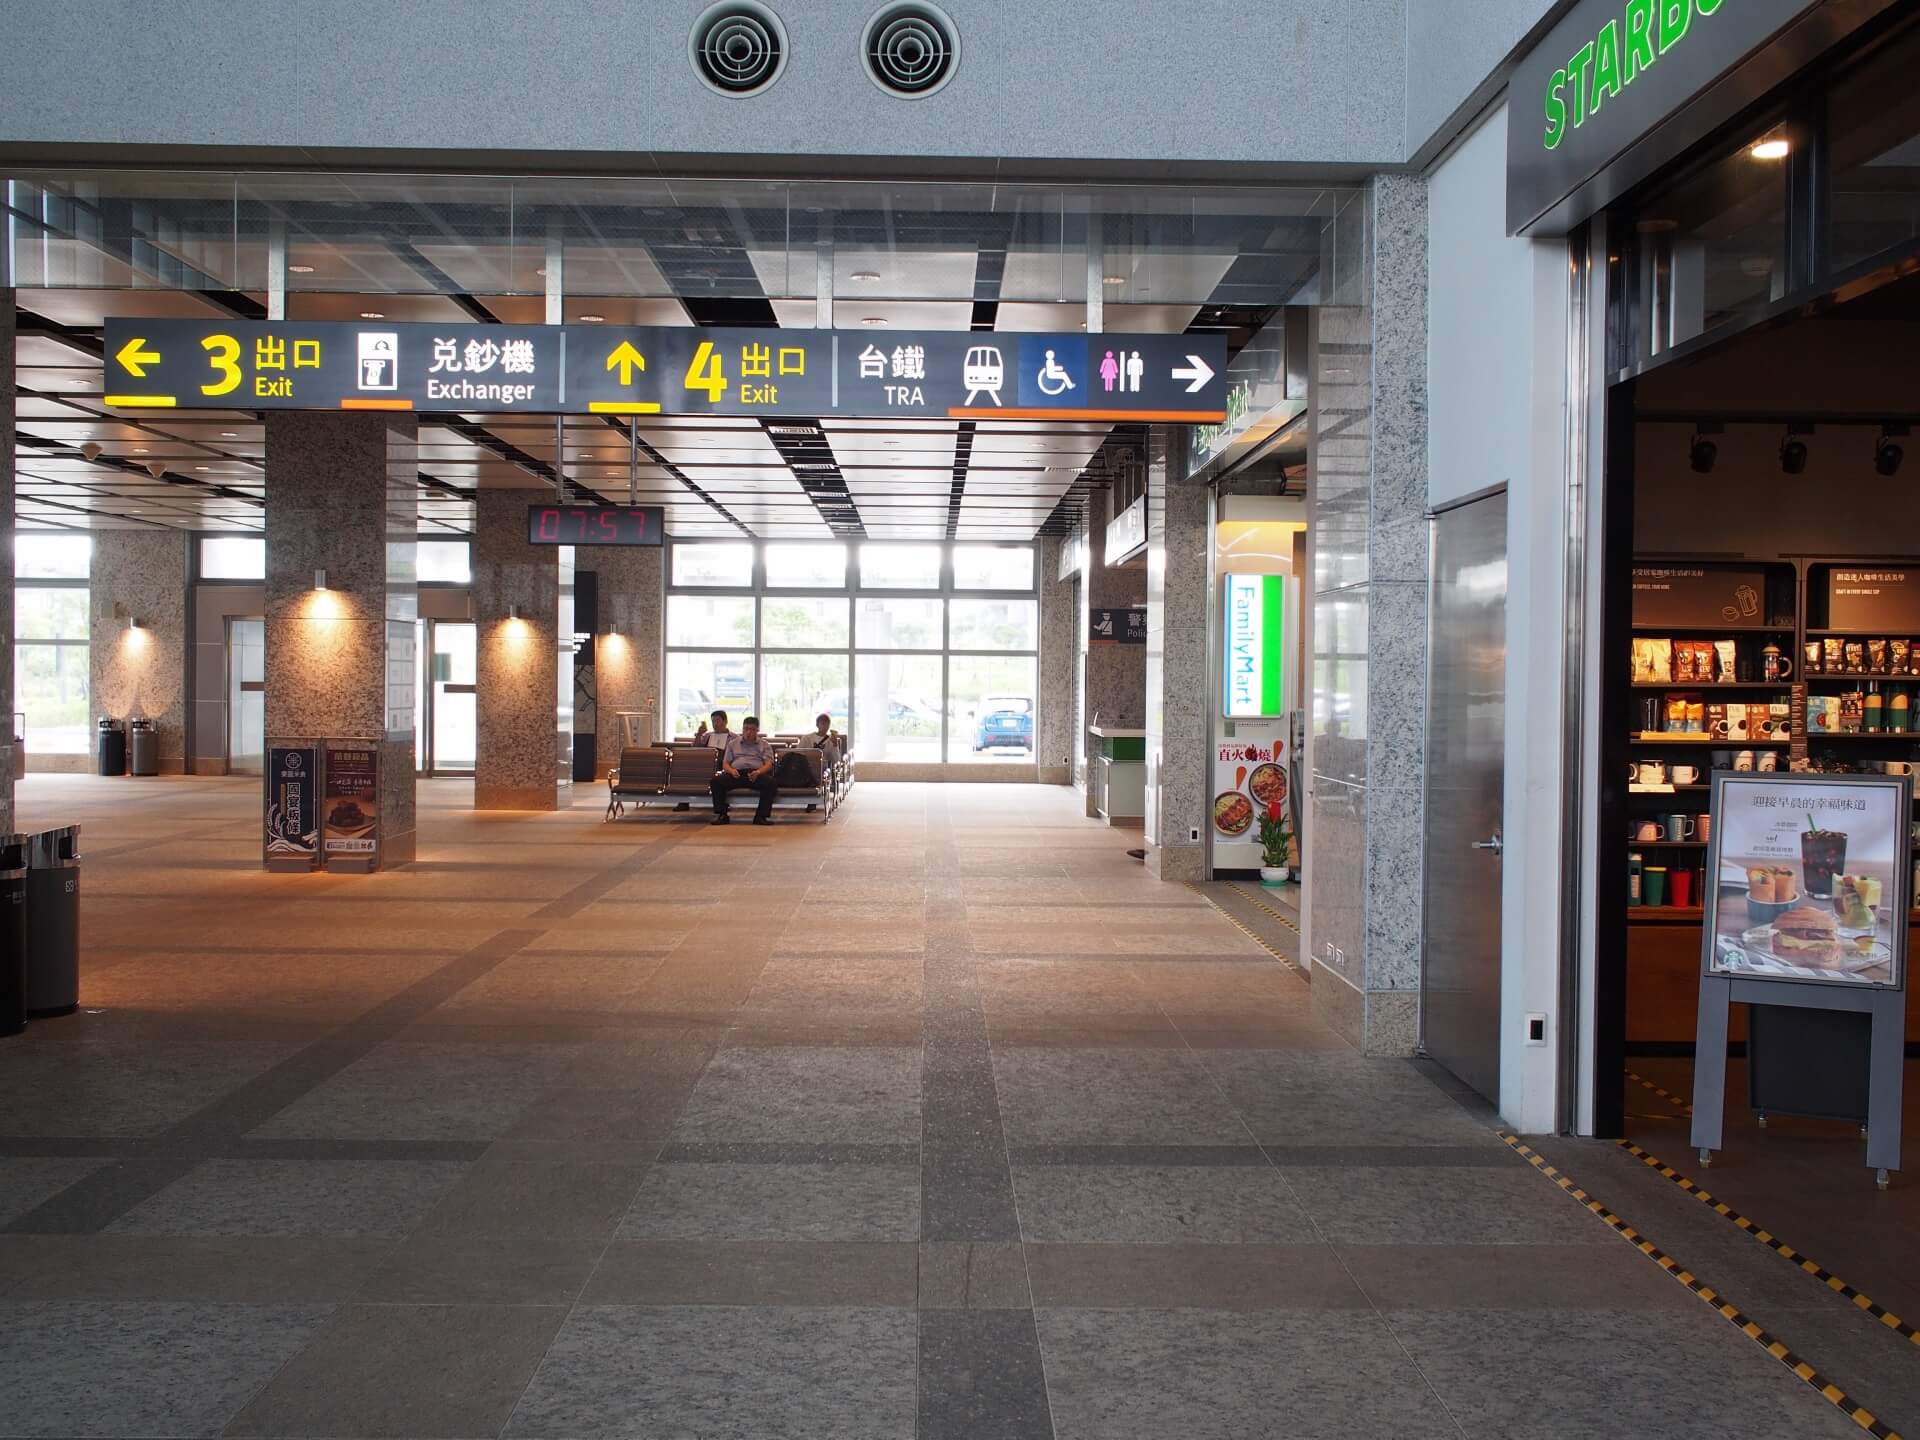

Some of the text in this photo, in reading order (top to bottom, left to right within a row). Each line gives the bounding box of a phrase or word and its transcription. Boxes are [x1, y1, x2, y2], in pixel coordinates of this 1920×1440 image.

[1544, 0, 1726, 150] STARB
[201, 335, 242, 396] 3
[255, 336, 320, 371] 出口
[428, 338, 535, 374] 兌鈔機
[741, 342, 805, 378] 出口
[857, 343, 925, 380] 台鐵
[255, 376, 293, 397] Exit
[684, 342, 728, 403] 4
[427, 379, 535, 405] Exchanger
[741, 384, 778, 404] Exit
[884, 385, 925, 406] TRA
[539, 509, 646, 541] 07:57
[1233, 586, 1255, 705] FamilyMart
[1752, 795, 1867, 811] 迎接早晨的幸福味道
